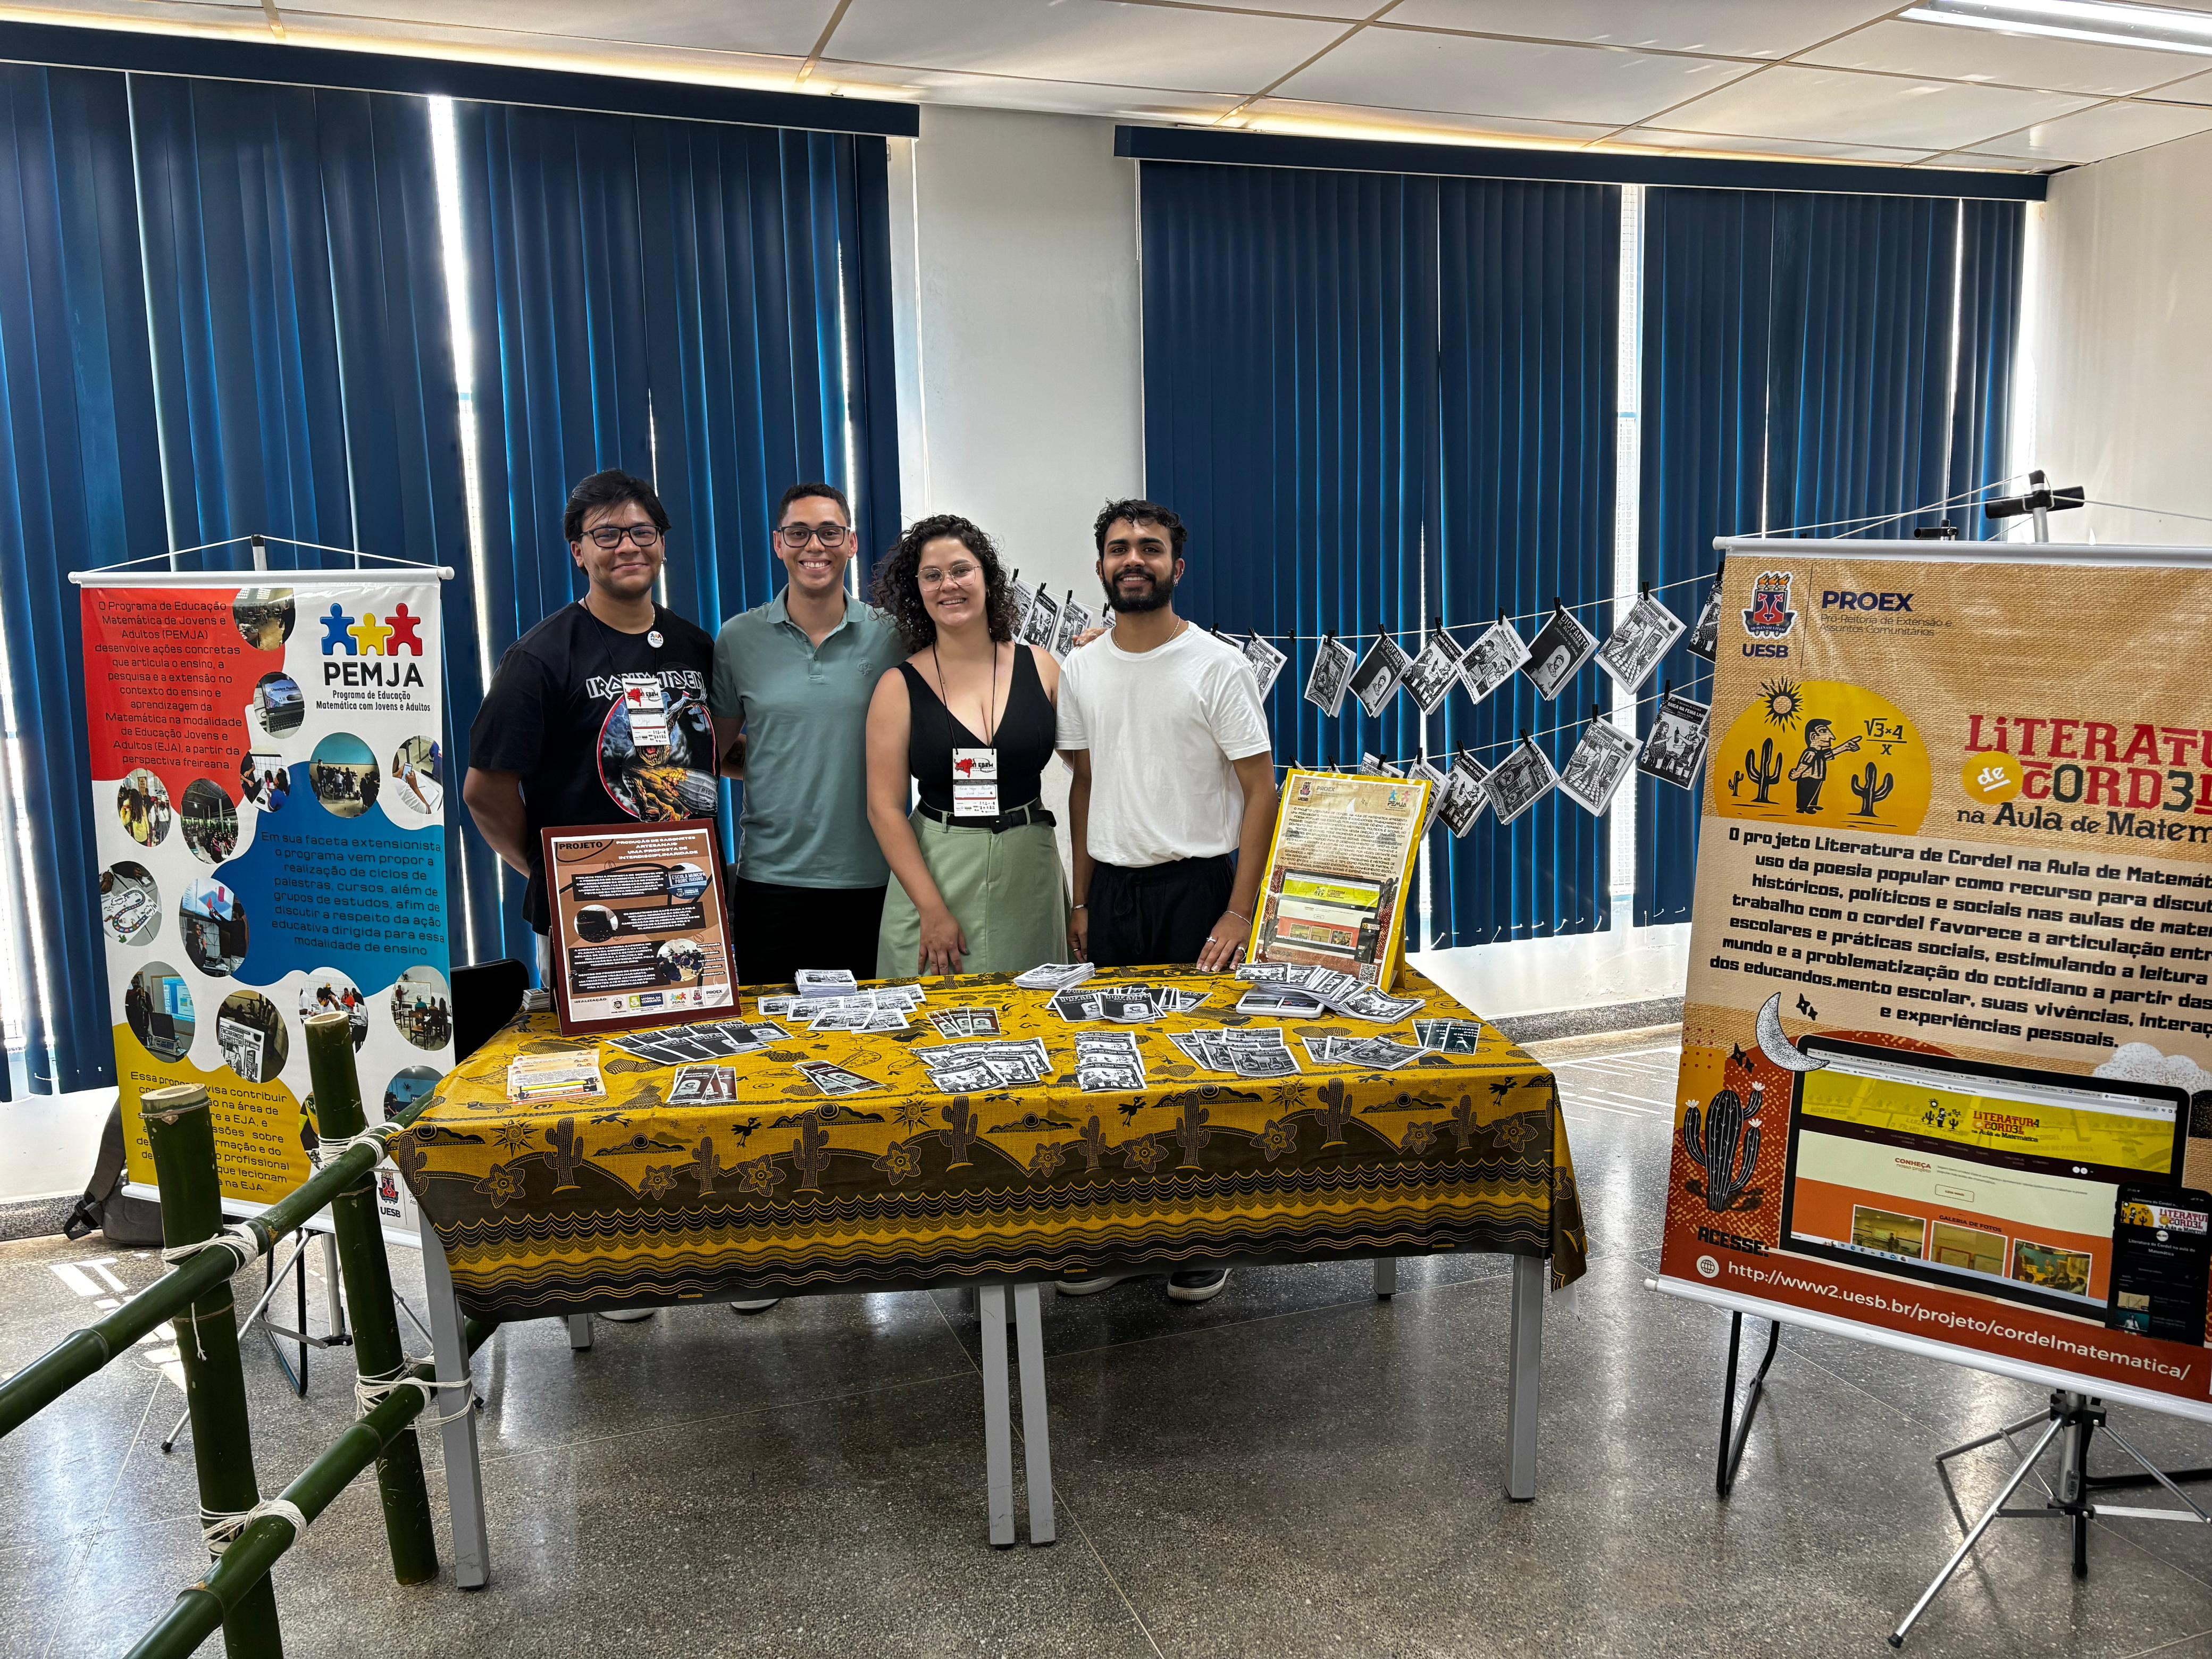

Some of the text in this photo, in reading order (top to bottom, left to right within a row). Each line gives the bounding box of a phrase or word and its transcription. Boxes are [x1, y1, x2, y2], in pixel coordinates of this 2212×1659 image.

[98, 601, 227, 613] O Programa de Educação
[1822, 591, 1915, 611] PROEX
[1637, 599, 1659, 622] ENCARANDO
[1638, 608, 1655, 627] CARESTIA
[103, 615, 162, 624] Matemática
[164, 616, 177, 625] de
[179, 616, 217, 625] Jovens
[1880, 617, 1894, 625] de
[1897, 617, 1942, 627] Extensão
[122, 630, 208, 639] Adultos (PEMJA)
[1560, 611, 1589, 650] DIOFANTO
[1819, 624, 1934, 636] Assuntos Comunitários
[95, 644, 240, 655] desenvolve ações concretas
[1384, 636, 1406, 669] DIOFANTO
[1742, 644, 1789, 658] UESB
[131, 659, 169, 667] articula
[180, 659, 215, 669] ensino,
[108, 672, 150, 682] pesquisa
[169, 674, 215, 683] extensão
[323, 661, 424, 687] PEMJA
[332, 690, 410, 702] Programa de Educação
[316, 700, 357, 710] Matemática
[375, 702, 398, 710] Jovens
[406, 702, 430, 711] Adultos
[1685, 707, 1697, 716] FEIRA
[1589, 724, 1613, 743] ENCARANDO
[1589, 732, 1609, 750] CARESTIA
[1362, 761, 1382, 776] ENCARANDO
[1978, 766, 2005, 786] de
[1489, 785, 1504, 815] PROMOÇÃO
[1957, 809, 1985, 824] na
[1993, 802, 2062, 831] Aula
[2071, 816, 2101, 834] de
[262, 832, 442, 853] Em sua faceta extensionista,
[559, 842, 603, 850] PROJETO
[285, 849, 344, 861] programa
[348, 853, 375, 862] vem
[379, 855, 424, 866] propor
[428, 858, 434, 866] a
[1729, 827, 1739, 841] O
[1744, 832, 1811, 849] projeto
[1815, 836, 1914, 859] Literatura
[1920, 848, 1943, 862] de
[1948, 850, 2012, 869] Cordel
[2017, 859, 2041, 872] na
[2047, 860, 2090, 877] Aula
[2096, 865, 2121, 879] de
[1756, 855, 1784, 868] uso
[1789, 857, 1809, 871] da
[1814, 862, 1872, 878] poesia
[1877, 868, 1949, 886] popular
[1955, 877, 2004, 892] como
[2009, 882, 2092, 901] recurso
[2098, 892, 2147, 907] para
[1753, 874, 1844, 899] históricos,
[1849, 888, 1930, 908] políticos
[1936, 898, 1947, 908] e
[1953, 900, 2021, 918] sociais
[2027, 907, 2063, 921] nas
[2069, 912, 2124, 928] aulas
[2131, 917, 2155, 932] de
[1733, 894, 1804, 915] trabalho
[1809, 907, 1842, 920] com
[1847, 911, 1858, 923] o
[1863, 914, 1924, 930] cordel
[1930, 917, 2022, 941] favorece
[2028, 932, 2040, 943] a
[2046, 934, 2165, 959] articulação
[1880, 1007, 2119, 1049] e experiências pessoais.
[130, 1071, 157, 1082] Essa
[230, 1089, 287, 1103] contribuir
[238, 1101, 263, 1113] área
[265, 1106, 279, 1115] de
[233, 1115, 259, 1127] EJA,
[253, 1132, 284, 1143] sobre
[2001, 1132, 2039, 1142] Matemática
[1895, 1157, 1931, 1170] CONHEÇA
[380, 1206, 401, 1218] UESB
[1939, 1215, 1967, 1225] GALERIA
[1980, 1224, 2002, 1232] FOTOS
[1698, 1226, 1769, 1258] ACESSE:
[1728, 1261, 2191, 1381] http://www2.uesb.br/projeto/cordelmatematica/
